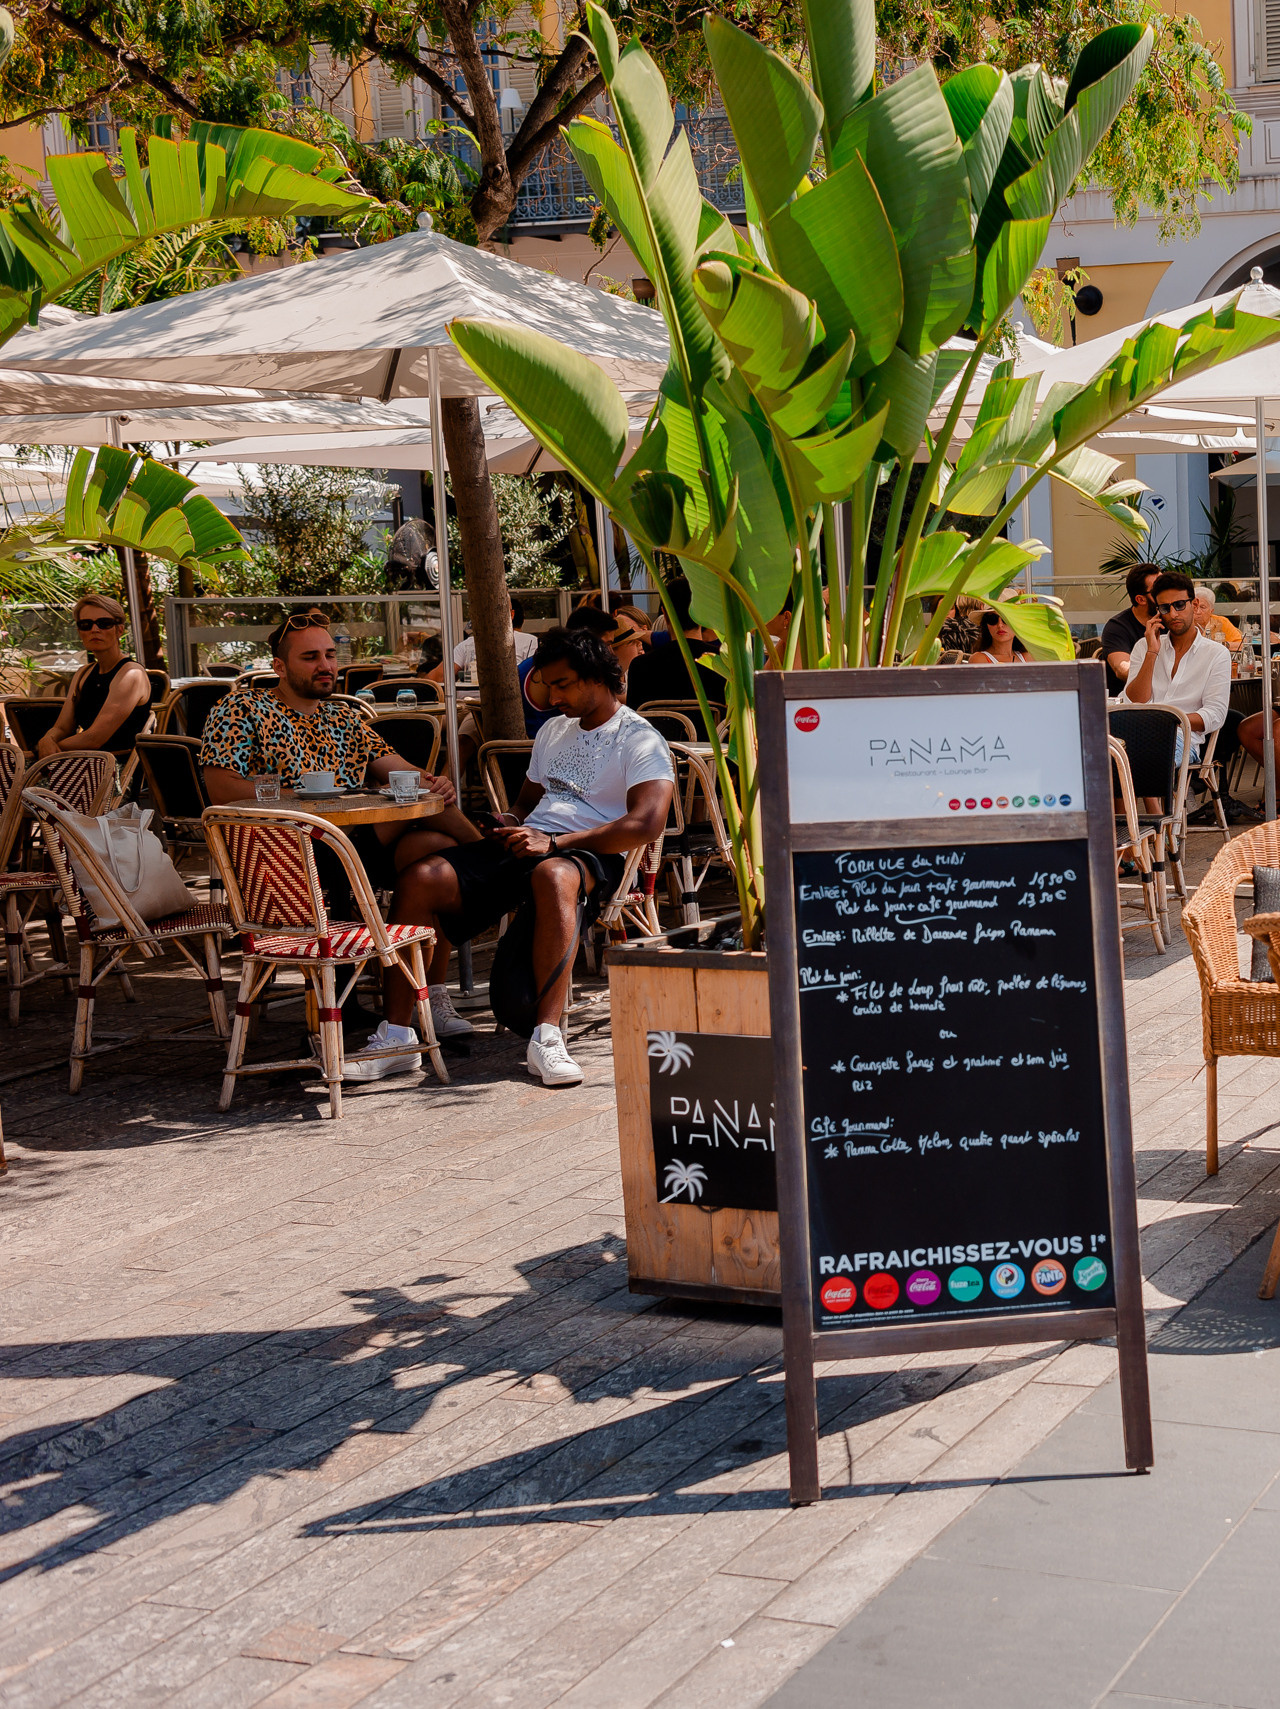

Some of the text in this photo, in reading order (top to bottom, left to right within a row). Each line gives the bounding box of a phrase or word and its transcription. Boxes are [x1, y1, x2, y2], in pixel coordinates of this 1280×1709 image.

[870, 736, 1010, 766] PANAMA
[944, 767, 972, 776] Lounge
[974, 766, 989, 775] Bar
[912, 855, 932, 867] du
[851, 880, 876, 896] Plat
[882, 882, 896, 894] du
[962, 877, 1016, 894] gourmand
[836, 899, 859, 915] Plat
[864, 900, 879, 912] du
[918, 896, 941, 912] café
[946, 896, 998, 915] gourmand
[852, 926, 895, 943] Rillette
[904, 929, 916, 940] de
[1011, 920, 1056, 936] Panama
[800, 967, 821, 985] Plat
[824, 969, 836, 981] du
[889, 983, 903, 997] de
[1036, 976, 1048, 989] de
[890, 1002, 902, 1012] de
[940, 1030, 957, 1038] ou
[943, 1056, 957, 1069] et
[1011, 1053, 1023, 1066] et
[1027, 1055, 1044, 1065] son
[811, 1116, 836, 1137] Café
[845, 1141, 879, 1157] Panna
[819, 1236, 1084, 1274] RAFRAICHISSEZ-VOUS
[1035, 1269, 1064, 1284] FANTA
[824, 1287, 852, 1300] Coca-Cola
[909, 1280, 937, 1293] Coca-Cola
